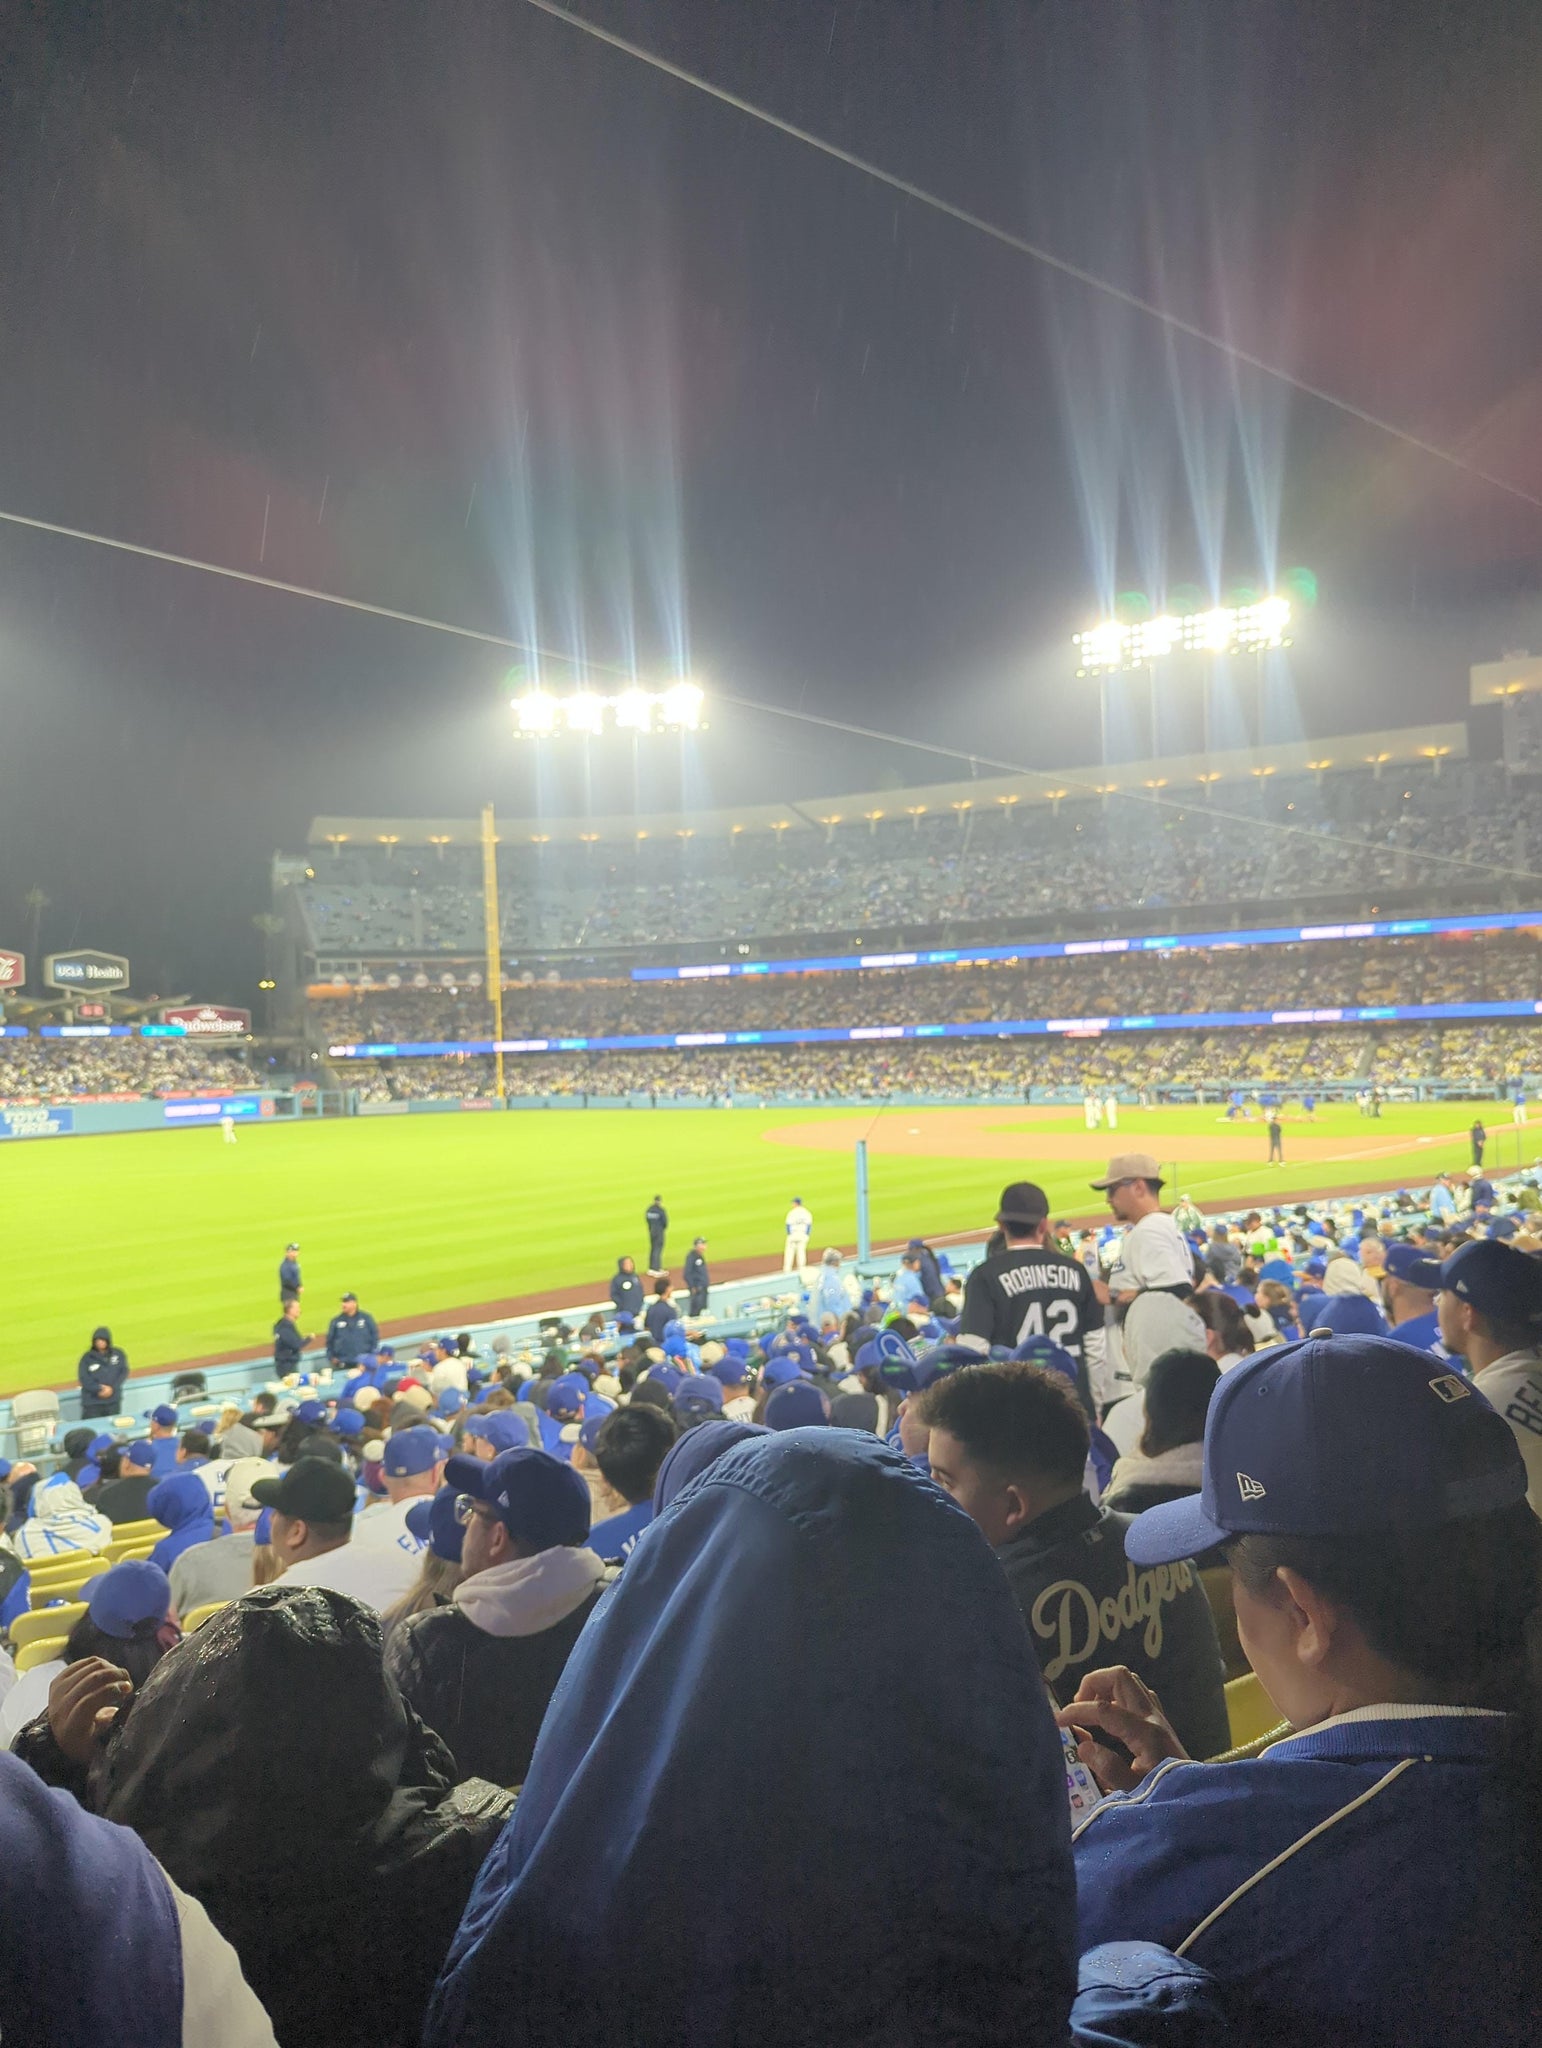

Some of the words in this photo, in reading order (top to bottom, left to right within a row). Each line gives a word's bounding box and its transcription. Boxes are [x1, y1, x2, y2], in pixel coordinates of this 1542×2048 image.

[86, 964, 123, 978] Health
[998, 1264, 1080, 1298] ROBINSON
[1016, 1299, 1080, 1357] 42
[1031, 1558, 1193, 1682] Dodgers
